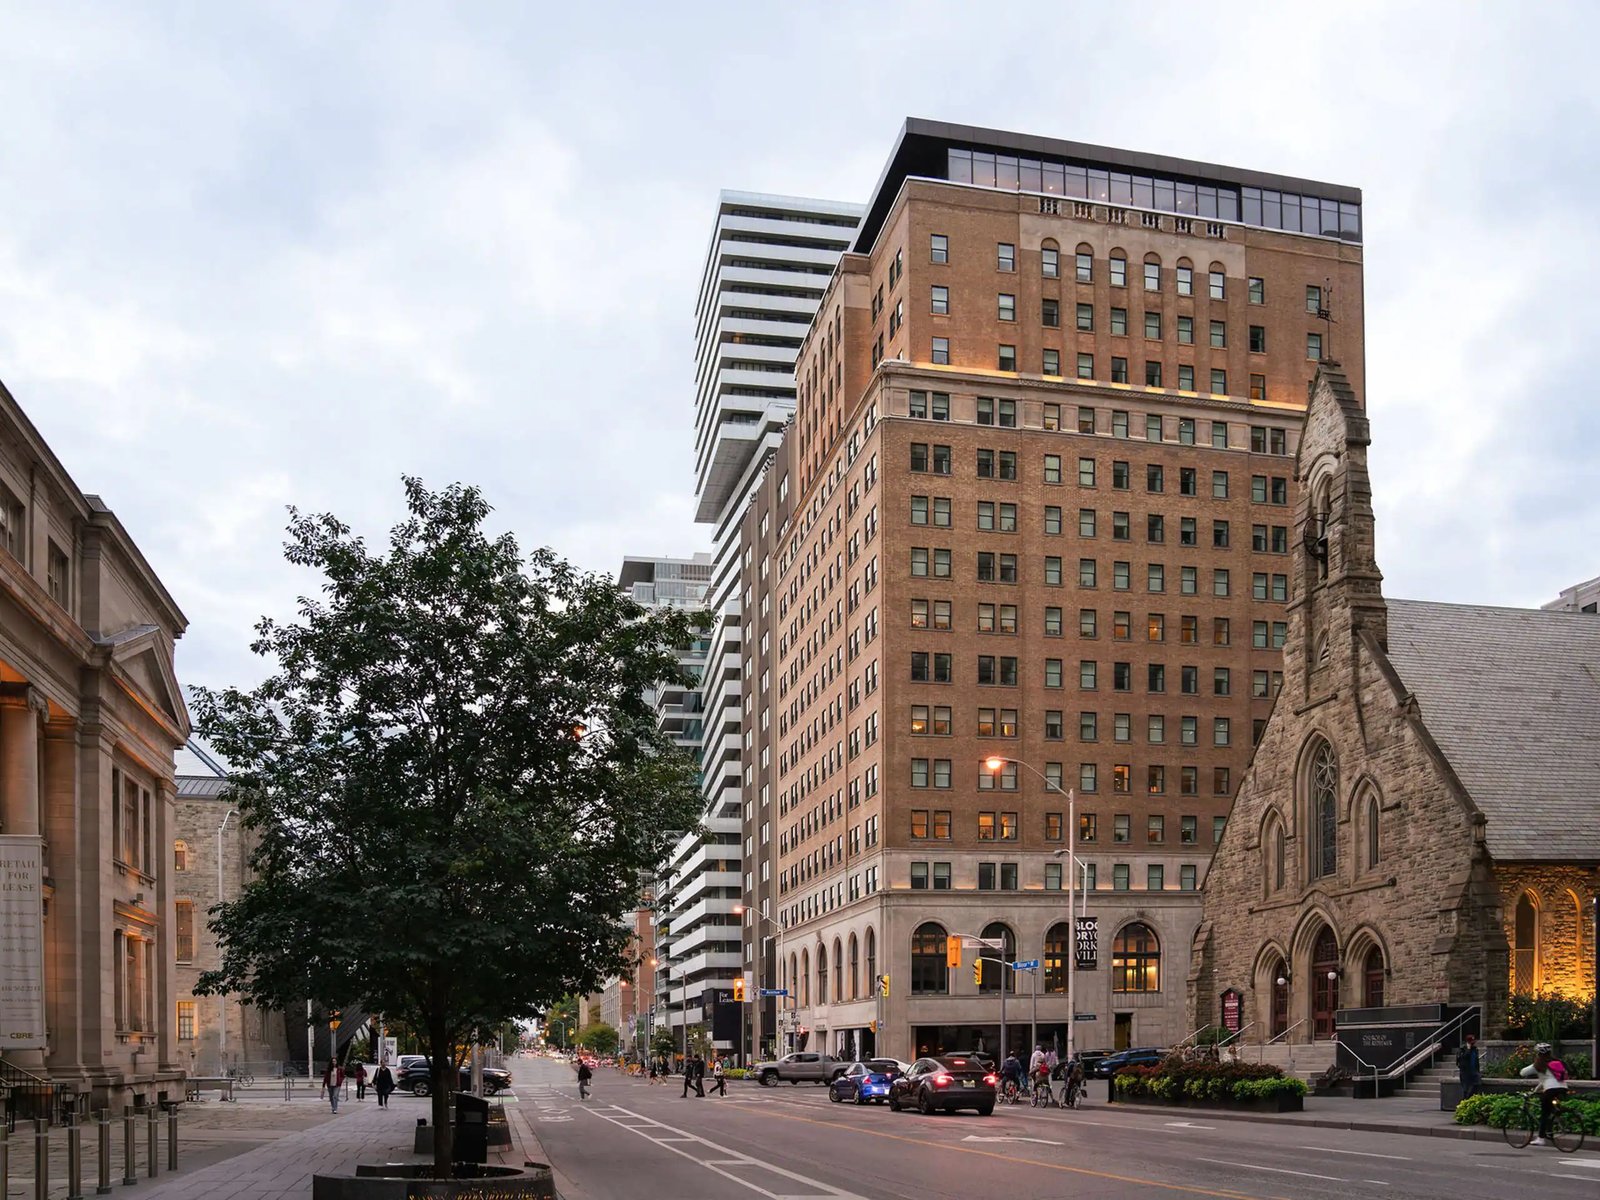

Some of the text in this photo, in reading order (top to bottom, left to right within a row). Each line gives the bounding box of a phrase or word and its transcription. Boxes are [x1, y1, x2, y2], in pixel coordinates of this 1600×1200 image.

[0, 860, 37, 868] RETAIL
[8, 871, 29, 880] FOR
[2, 884, 35, 892] LEASE
[9, 1032, 34, 1040] CBRE
